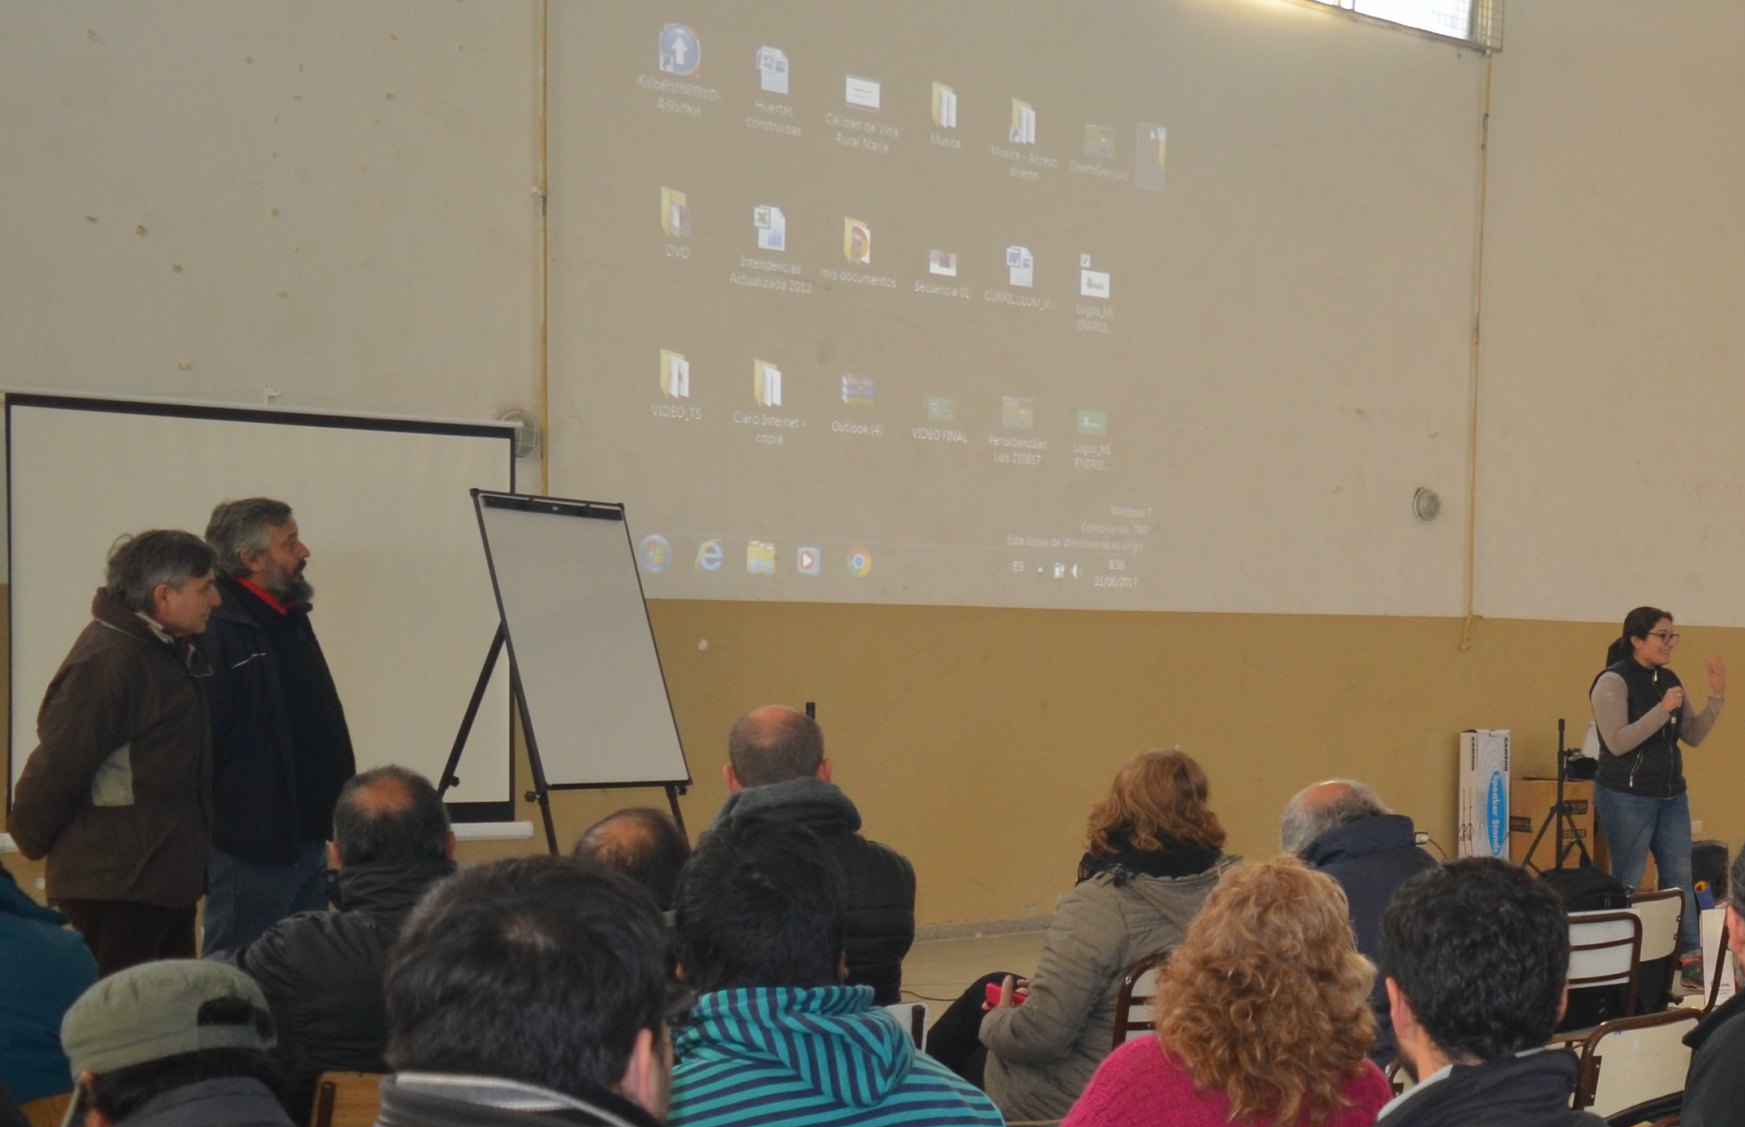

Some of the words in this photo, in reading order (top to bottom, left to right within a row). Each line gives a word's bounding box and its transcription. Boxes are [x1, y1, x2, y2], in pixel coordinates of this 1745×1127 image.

[755, 99, 793, 117] Huertas
[746, 118, 802, 137] construidas
[826, 112, 862, 130] Calidad
[864, 122, 876, 133] de
[879, 122, 900, 138] Vida
[836, 132, 860, 148] Rural
[1028, 153, 1058, 169] Acceso
[1009, 167, 1040, 181] directo
[665, 244, 690, 260] DVD
[740, 254, 802, 275] Intendencias
[729, 272, 786, 291] Actualizada
[789, 279, 812, 294] 2012
[820, 268, 837, 280] mis
[839, 271, 896, 289] documentos
[914, 279, 957, 297] Secuencia
[959, 285, 970, 299] 01
[651, 404, 703, 421] VIDEO_TS
[732, 411, 760, 425] Claro
[761, 413, 800, 429] Internet
[831, 419, 869, 435] Outlook
[870, 423, 884, 438] (4)
[911, 426, 941, 441] VIDEO
[942, 430, 968, 444] FINAL
[755, 433, 783, 446] copia
[1110, 505, 1146, 518] Windows
[1007, 534, 1025, 547] Esta
[1026, 536, 1049, 549] copia
[1050, 537, 1061, 548] de
[1062, 537, 1098, 550] Windows
[1100, 541, 1110, 550] no
[1111, 542, 1121, 551] es
[1013, 560, 1024, 572] ES
[1094, 575, 1138, 589] 21/06/2017
[1490, 774, 1500, 817] Speaker
[1490, 819, 1501, 853] Stands
